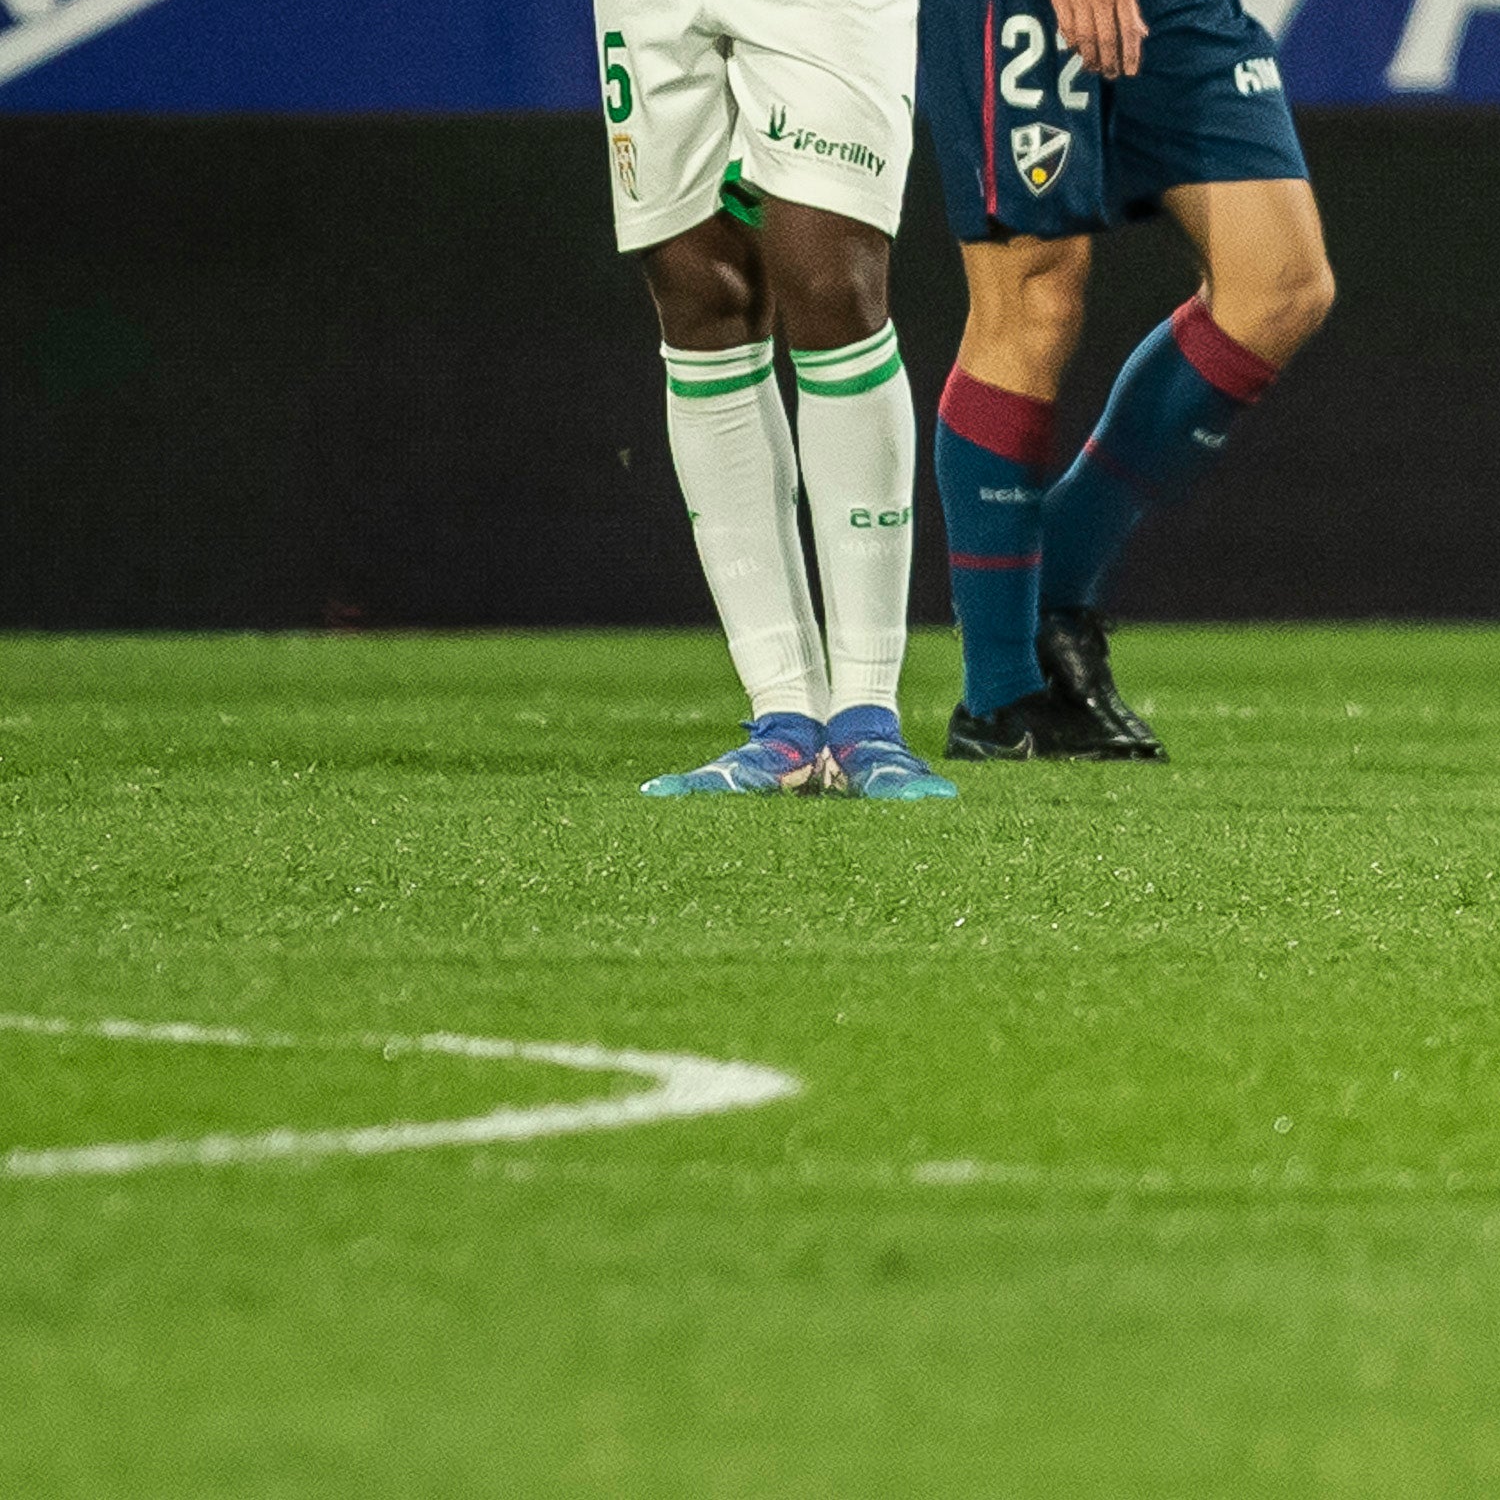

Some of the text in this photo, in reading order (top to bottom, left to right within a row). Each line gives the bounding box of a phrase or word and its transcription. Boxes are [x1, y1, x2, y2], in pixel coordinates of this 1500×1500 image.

[604, 31, 633, 123] 5
[1000, 14, 1090, 111] 22
[793, 128, 886, 177] iFertility
